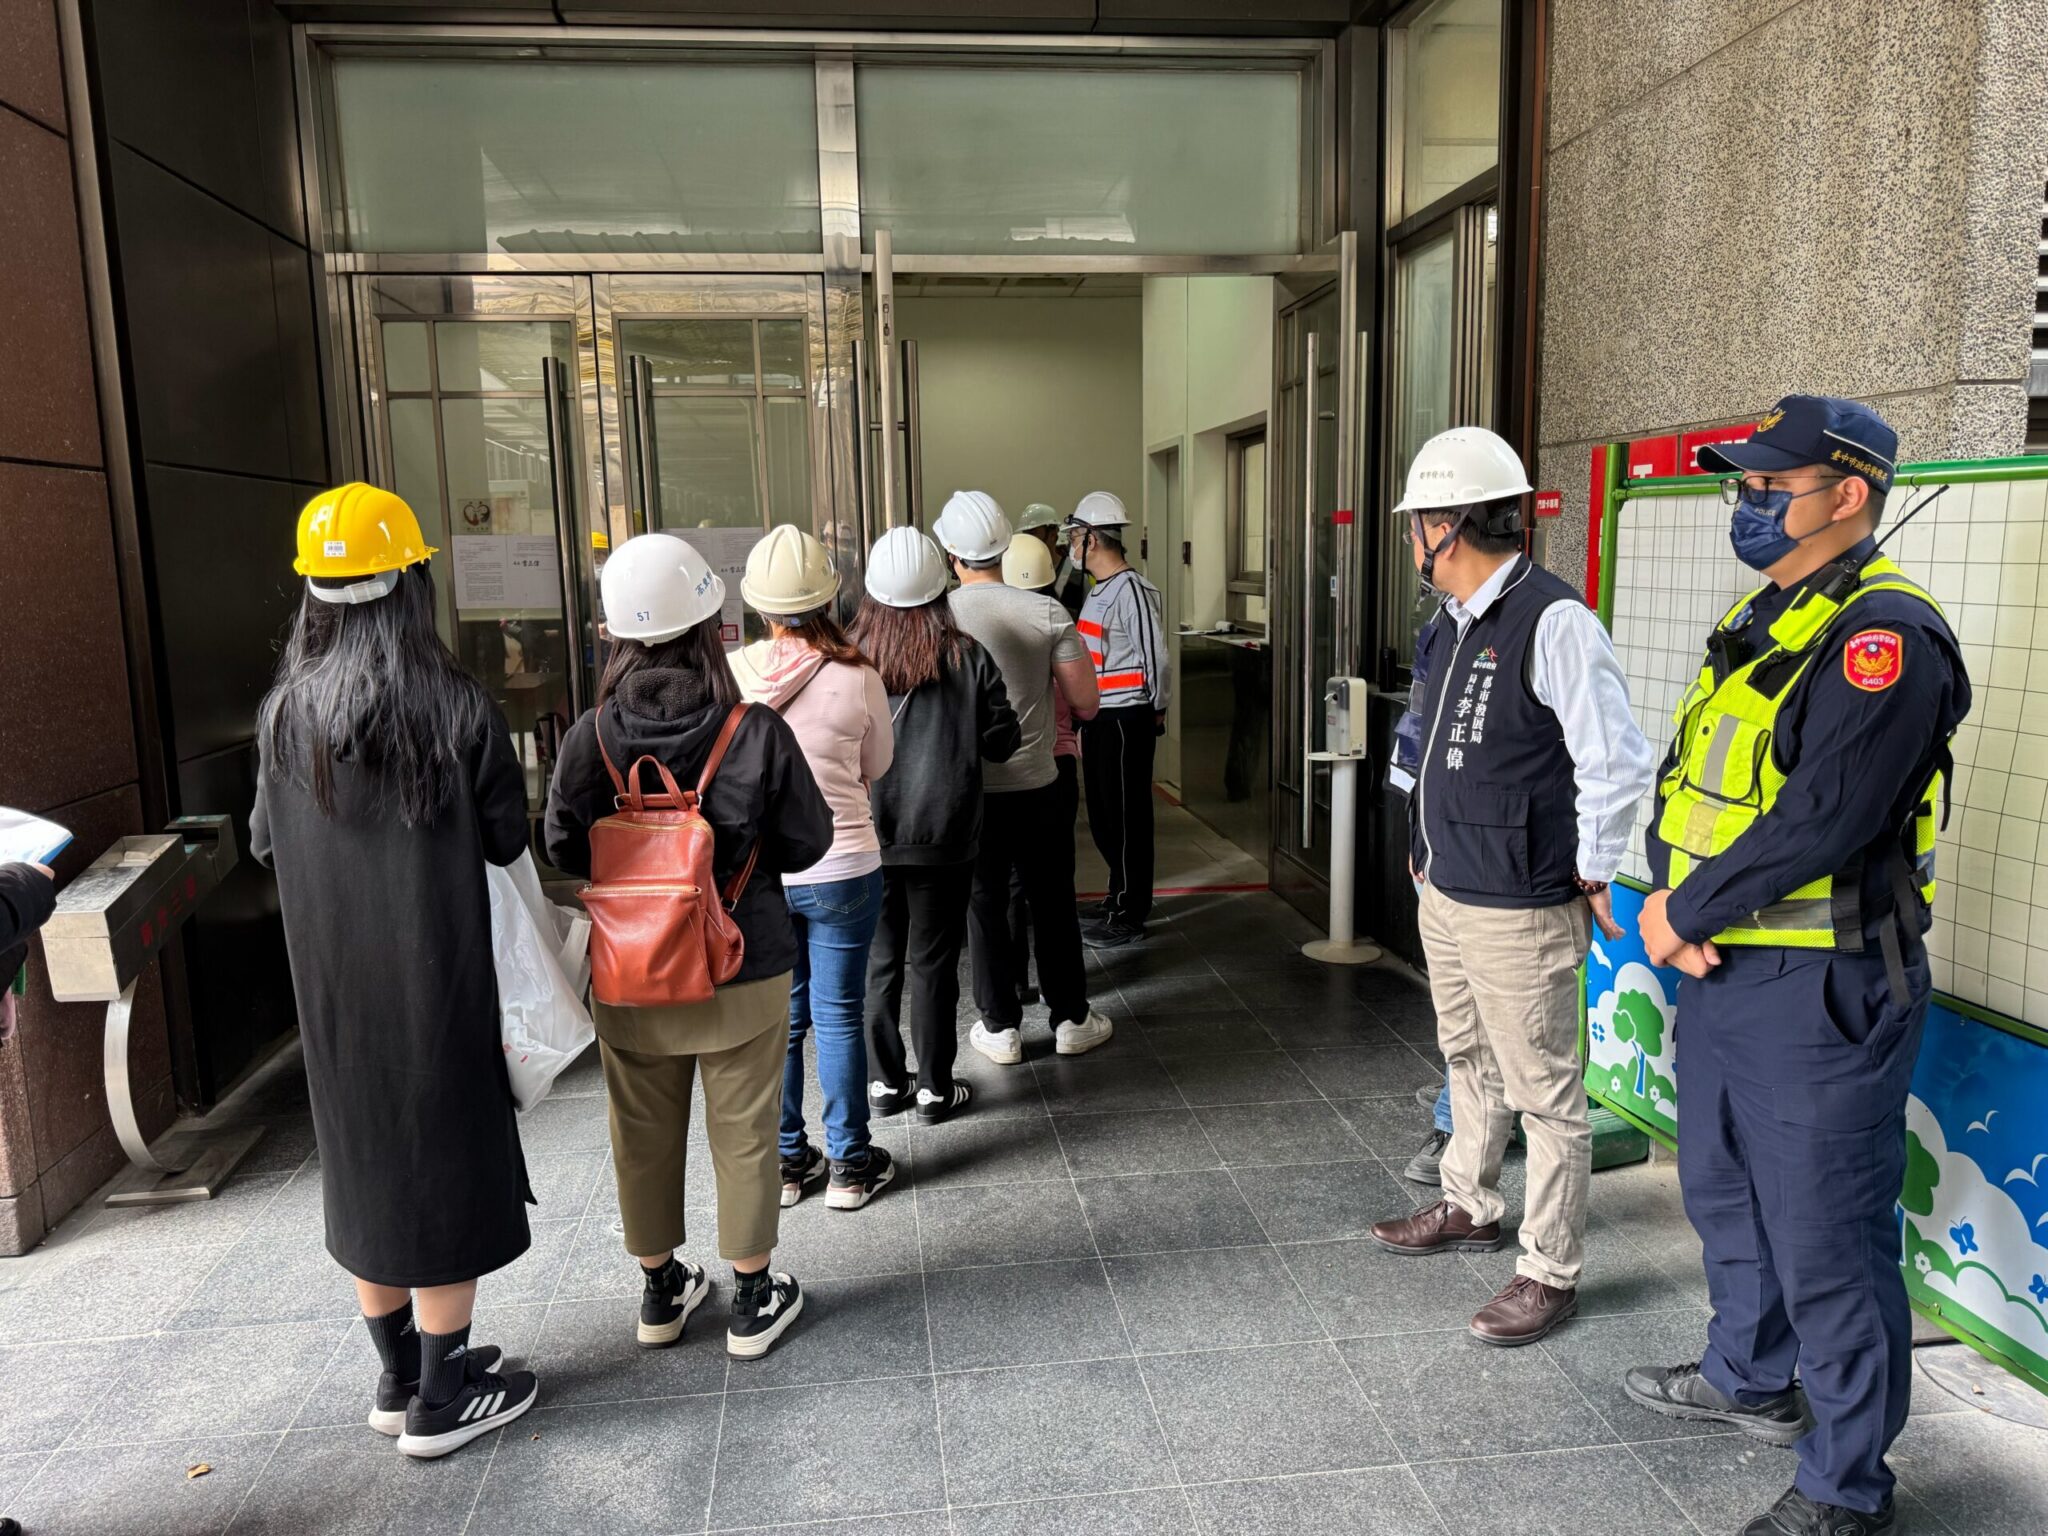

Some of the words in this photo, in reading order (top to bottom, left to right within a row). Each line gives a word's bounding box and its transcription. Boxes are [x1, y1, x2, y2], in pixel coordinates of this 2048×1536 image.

[1754, 507, 1777, 516] POLICE
[636, 611, 650, 621] 57
[1464, 673, 1478, 695] 局長
[1861, 677, 1884, 686] 6403
[1469, 675, 1494, 745] 都市發展局
[1446, 697, 1473, 771] 李正偉
